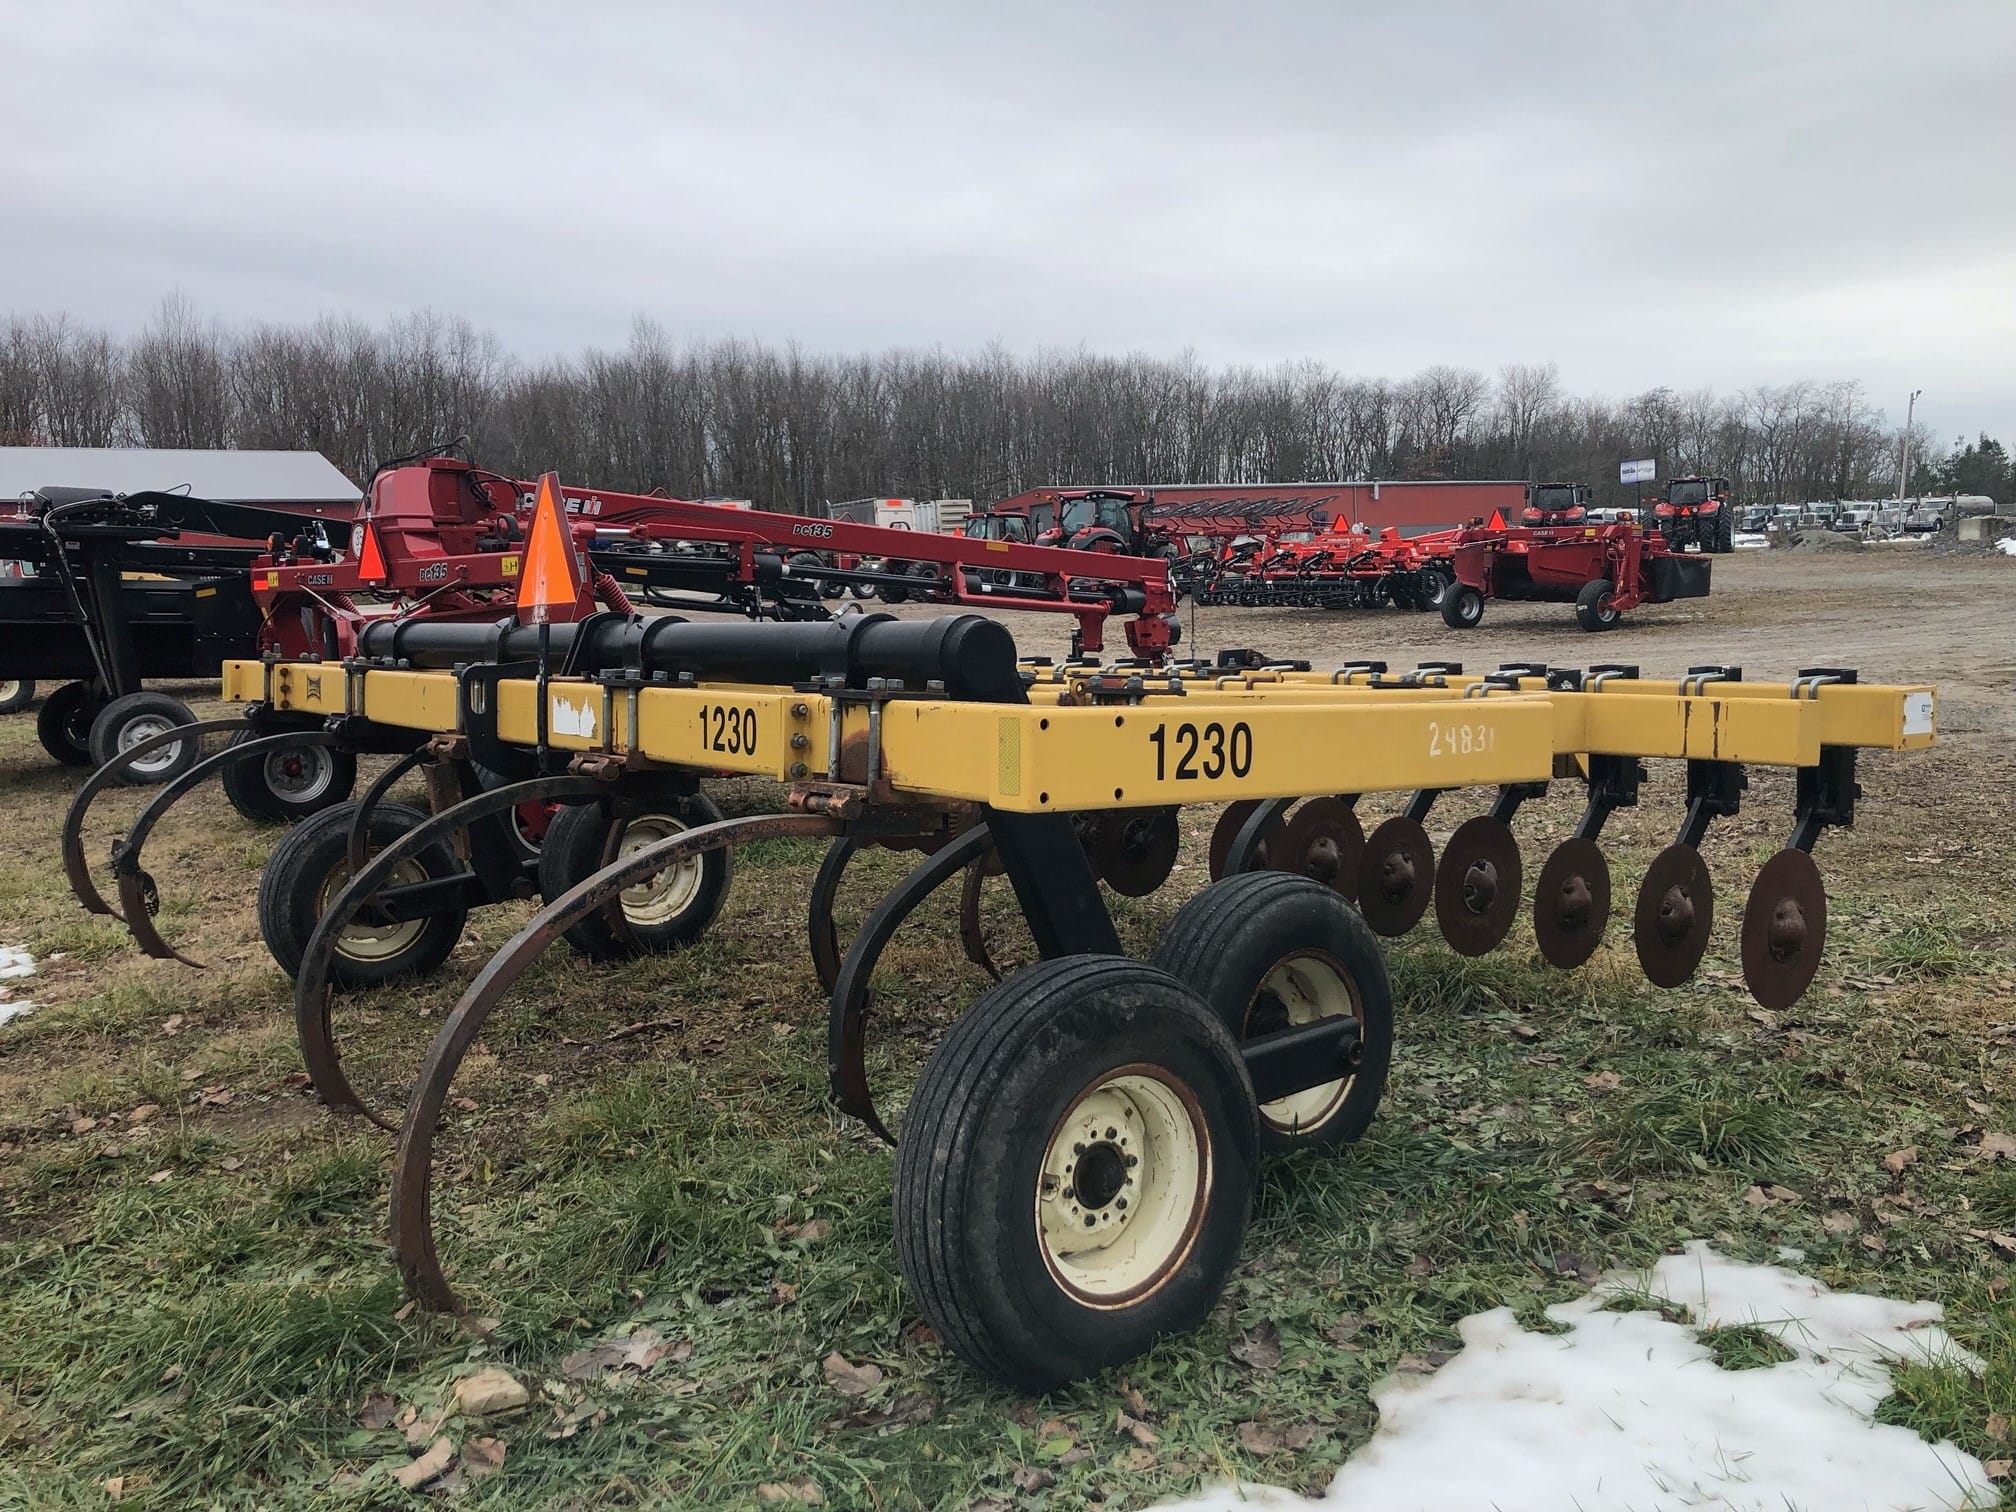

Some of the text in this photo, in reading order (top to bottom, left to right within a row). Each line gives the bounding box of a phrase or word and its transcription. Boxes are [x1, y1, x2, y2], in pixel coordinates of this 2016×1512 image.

[793, 523, 833, 538] DC135
[307, 574, 326, 585] CASE
[419, 562, 448, 582] DC135
[699, 704, 757, 756] 1230
[1428, 721, 1494, 757] 24831
[1149, 721, 1253, 781] 1230
